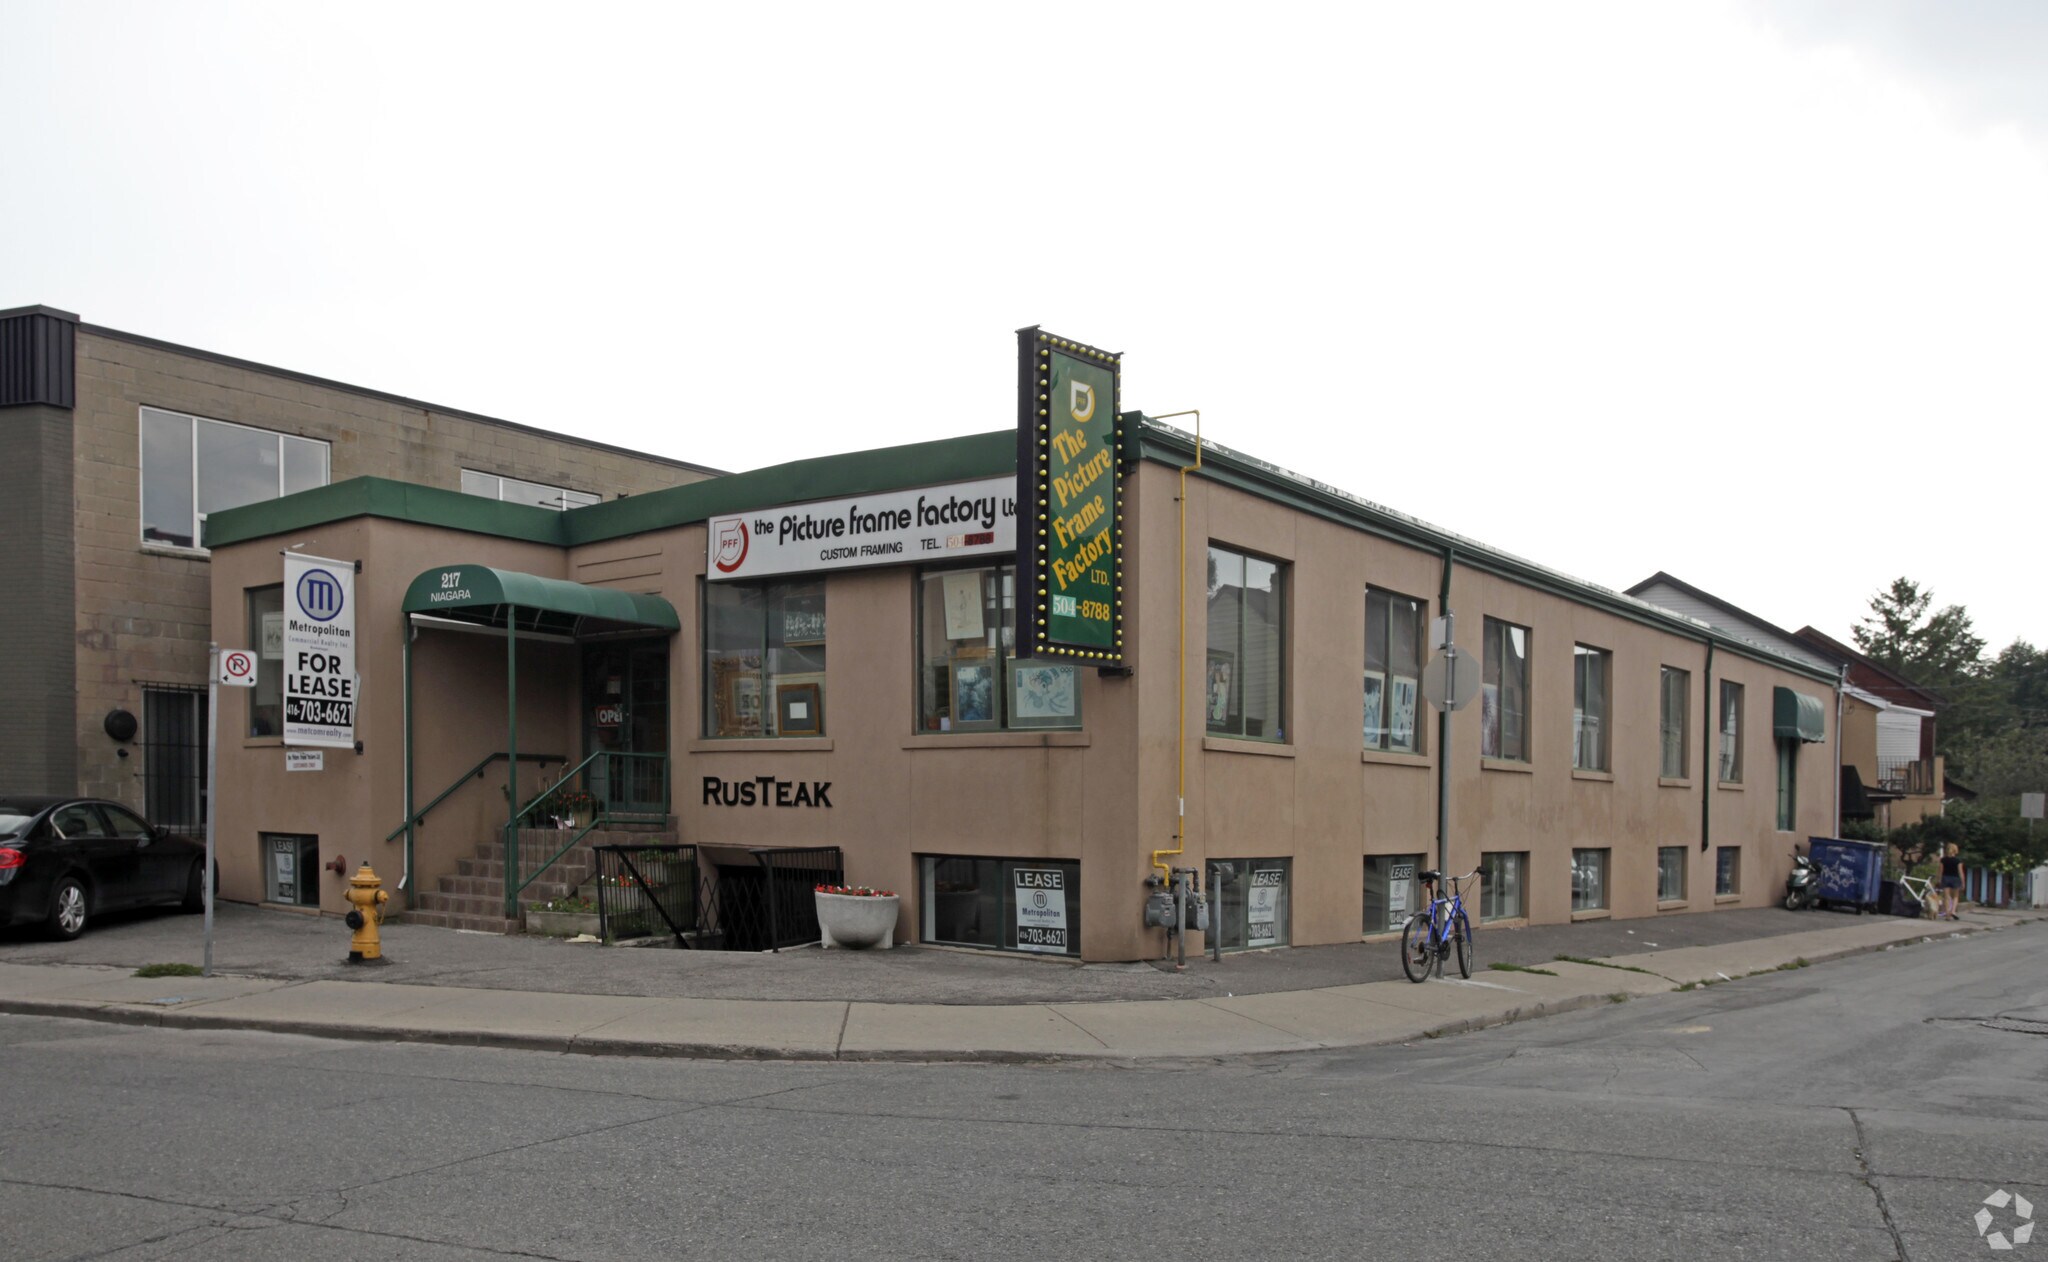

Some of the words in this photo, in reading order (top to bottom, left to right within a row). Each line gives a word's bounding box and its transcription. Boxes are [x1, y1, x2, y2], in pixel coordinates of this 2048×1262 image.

[1052, 429, 1087, 465] The
[1052, 448, 1112, 508] Picture
[755, 519, 774, 535] the
[779, 514, 845, 546] Picture
[850, 505, 911, 535] frame
[917, 496, 996, 529] factory
[1052, 495, 1105, 549] Frame
[722, 538, 738, 549] PFF
[820, 546, 858, 561] CUSTOM
[860, 541, 903, 557] FRAMING
[921, 538, 942, 551] TEL.
[1052, 527, 1112, 591] Factory
[441, 571, 461, 589] 217
[1091, 568, 1110, 586] LTD.
[431, 589, 471, 602] NIAGARA
[1053, 595, 1110, 622] 504-8788
[289, 619, 351, 637] Metropolitan
[298, 651, 341, 675] FOR
[288, 674, 351, 698] LEASE
[287, 700, 352, 725] 416-703-6621
[1016, 872, 1062, 888] LEASE
[1252, 873, 1281, 886] LEASE
[1022, 907, 1061, 918] Metropolitan
